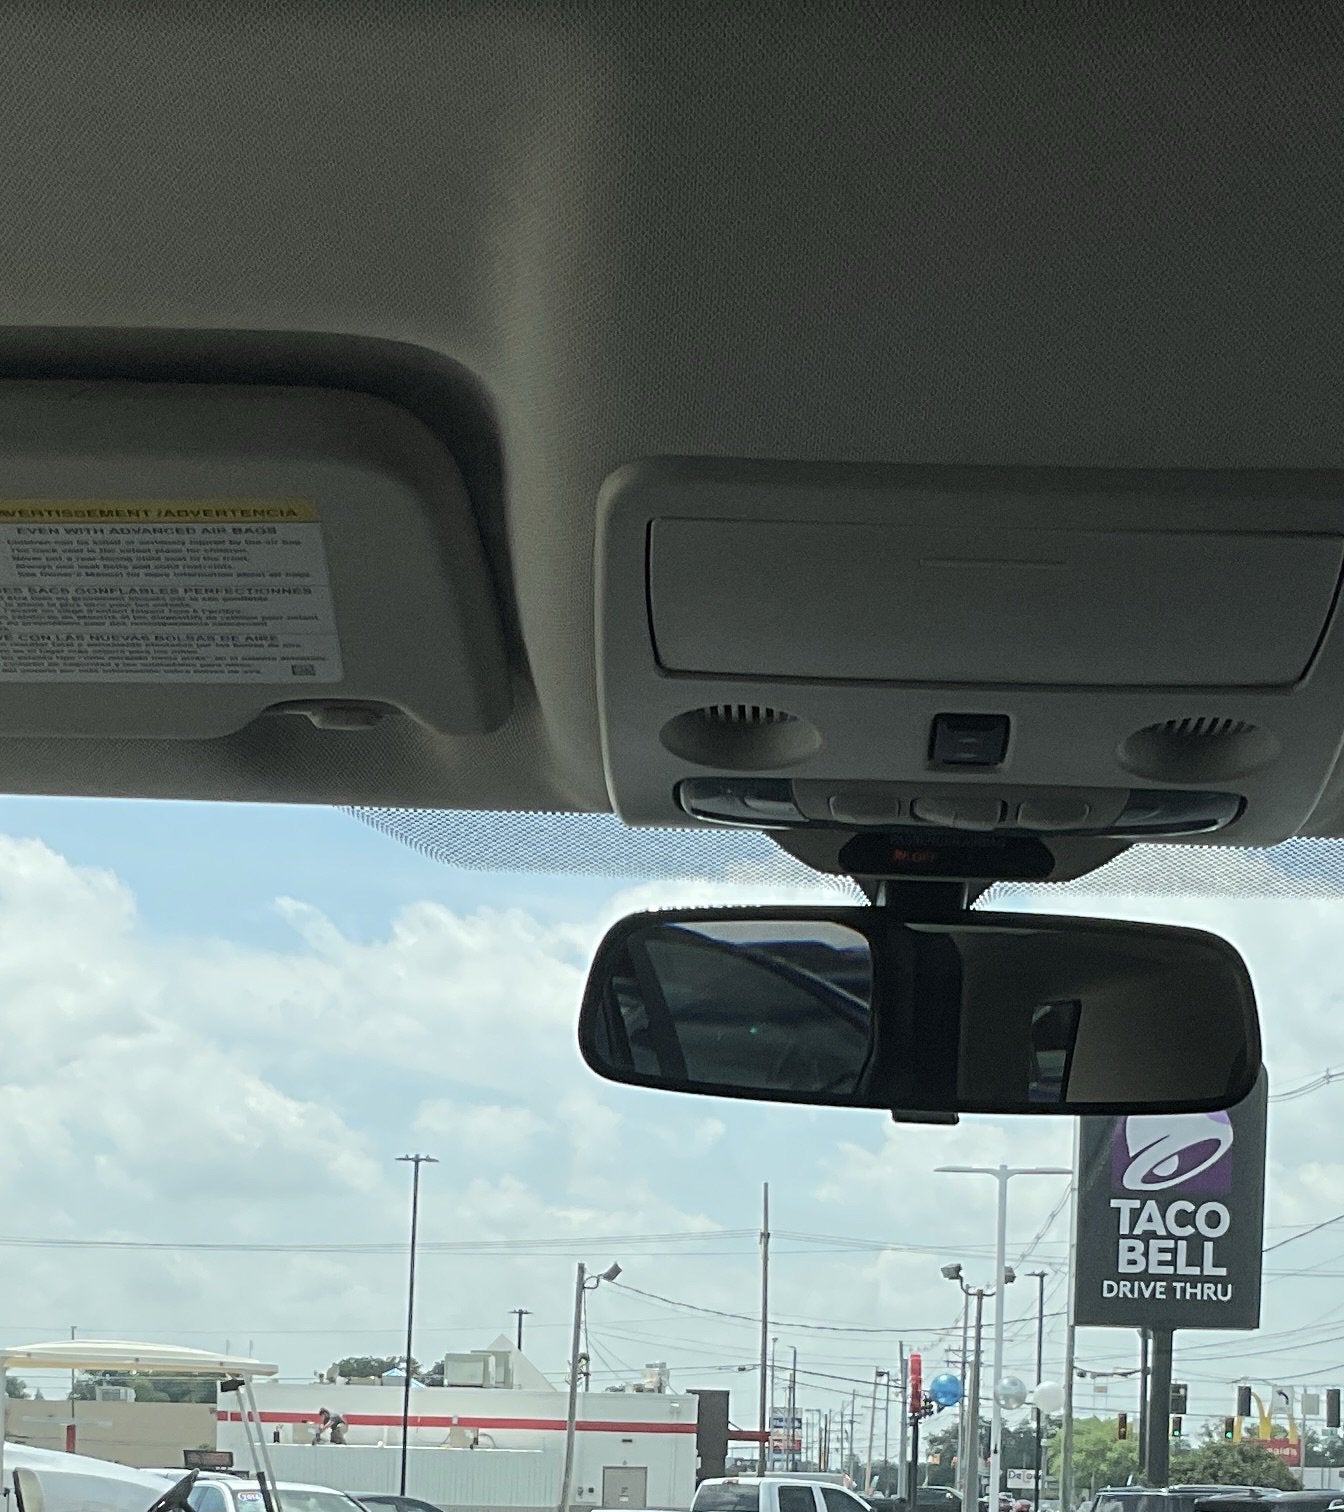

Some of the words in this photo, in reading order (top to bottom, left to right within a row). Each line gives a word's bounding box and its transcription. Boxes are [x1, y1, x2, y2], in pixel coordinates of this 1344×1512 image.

[1110, 1199, 1231, 1238] TACO
[1118, 1239, 1227, 1276] BELL
[1102, 1280, 1167, 1300] DRIVE
[1172, 1282, 1233, 1302] THRU
